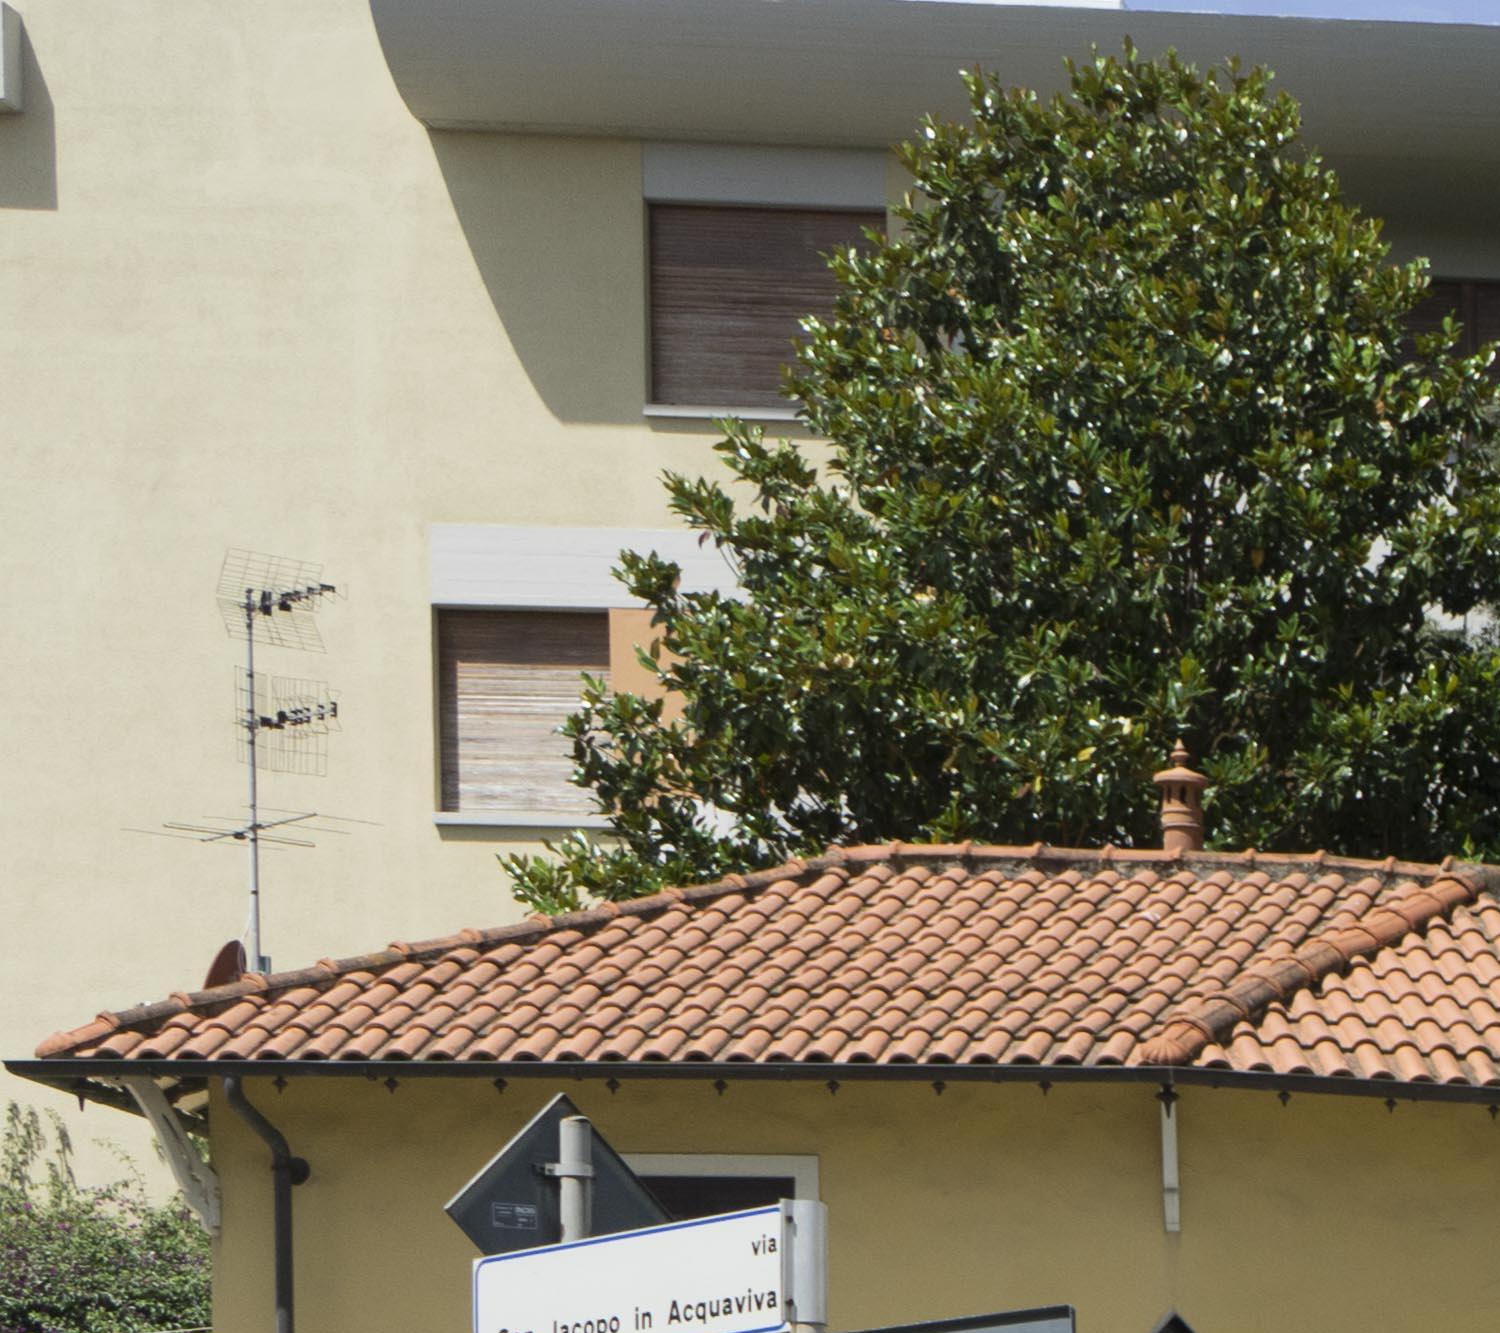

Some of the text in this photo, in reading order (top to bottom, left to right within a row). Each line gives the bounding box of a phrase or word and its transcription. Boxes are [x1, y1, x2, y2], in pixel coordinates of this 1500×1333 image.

[751, 1234, 778, 1256] via
[635, 1307, 652, 1330] in
[668, 1288, 778, 1325] Acquaviva
